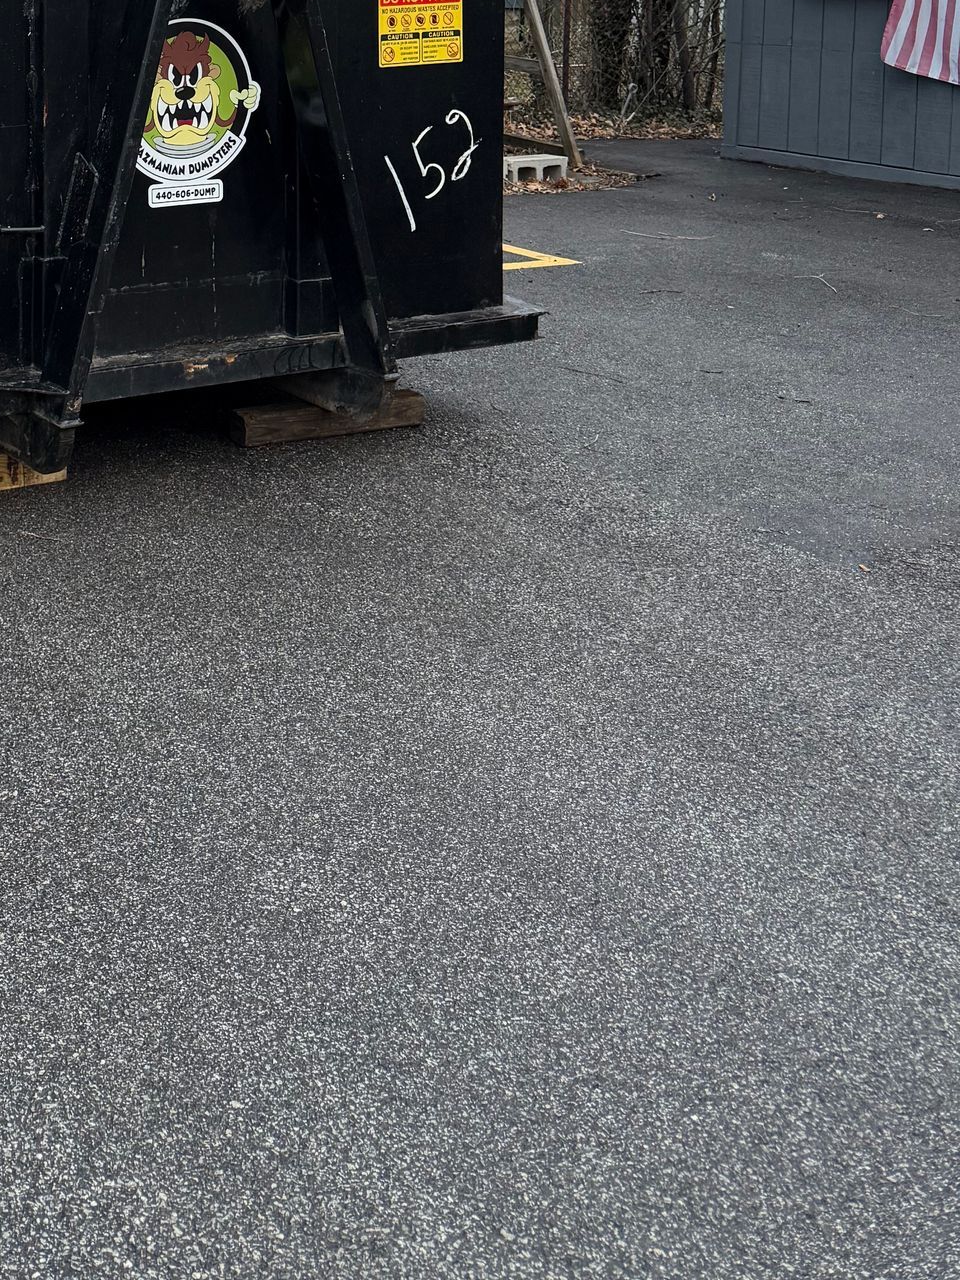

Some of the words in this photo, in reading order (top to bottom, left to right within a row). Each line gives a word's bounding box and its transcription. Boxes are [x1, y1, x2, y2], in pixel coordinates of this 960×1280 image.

[389, 6, 417, 14] HAZARDOUS
[428, 30, 454, 38] CAUTION
[138, 146, 186, 175] AZMANIAN
[188, 136, 237, 175] DUMPSTERS
[384, 109, 483, 232] 152
[155, 187, 216, 200] 440-606-DUMP
